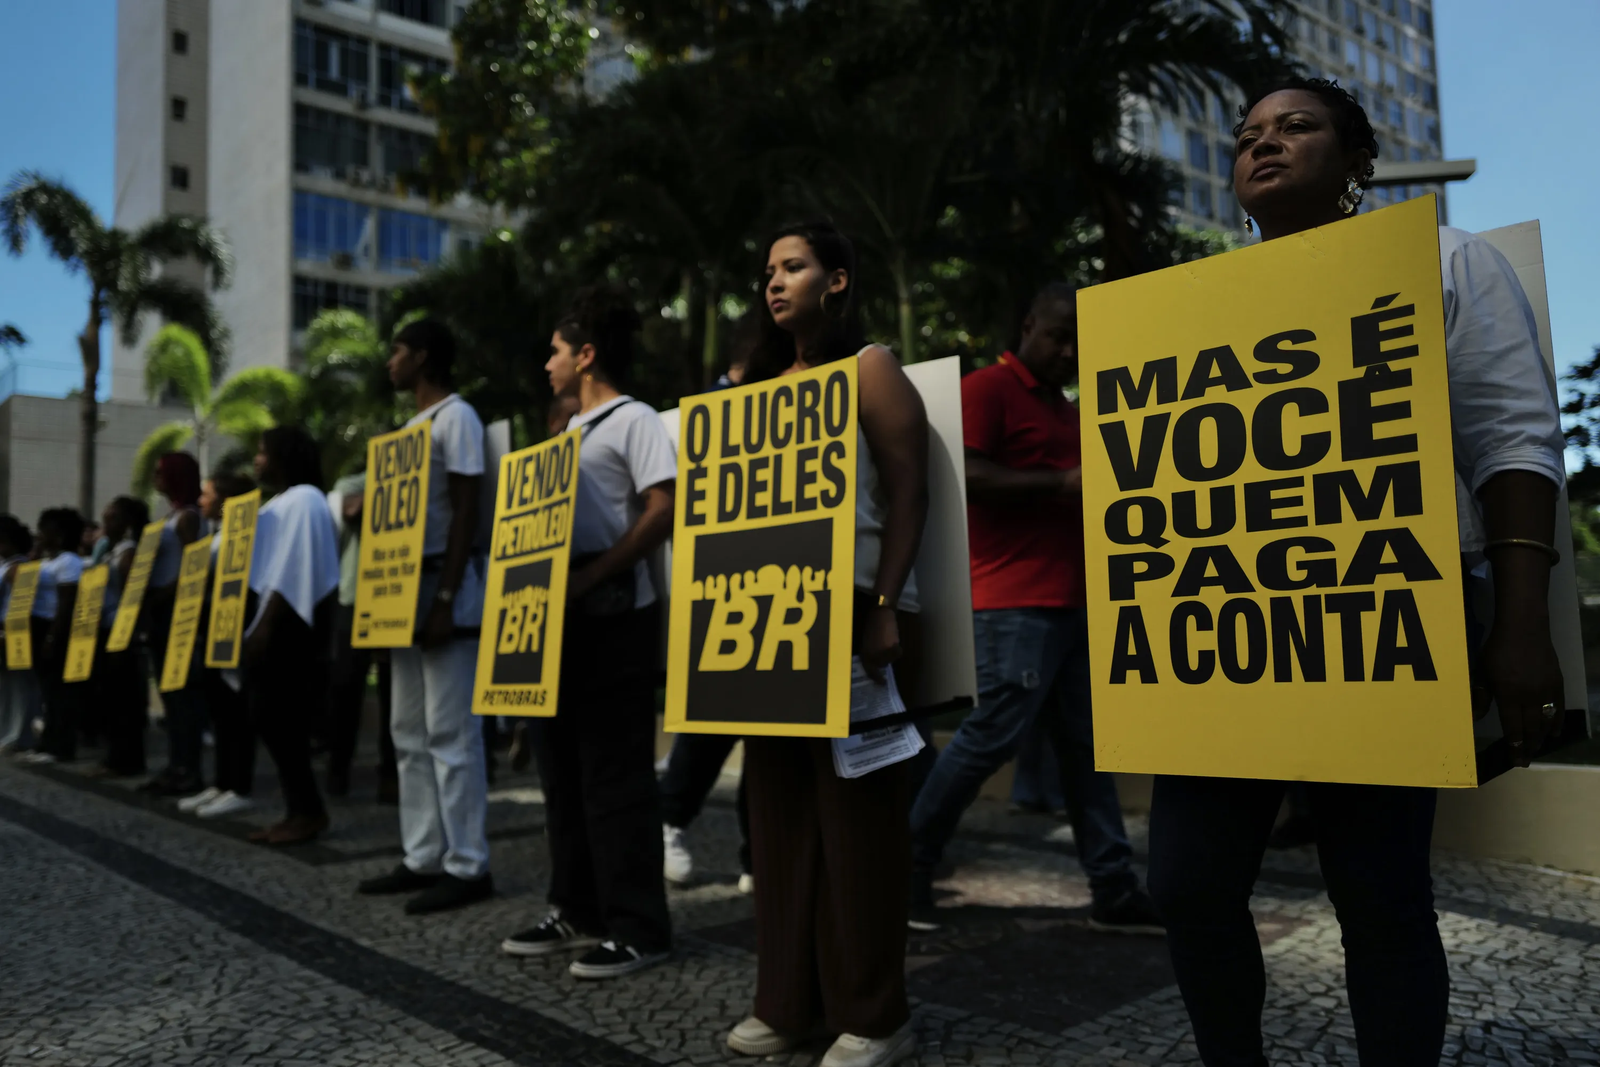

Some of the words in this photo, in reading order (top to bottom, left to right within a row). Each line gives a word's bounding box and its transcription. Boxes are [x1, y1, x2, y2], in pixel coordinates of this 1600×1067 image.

[1096, 328, 1321, 416] MAS
[1350, 292, 1419, 368] É
[375, 429, 425, 482] VENDO
[686, 404, 710, 464] O
[721, 370, 849, 459] LUCRO
[1097, 362, 1419, 492] VOCÊ
[505, 436, 574, 510] VENDO
[717, 440, 846, 523] DELES
[1103, 460, 1424, 549] QUEM
[1107, 526, 1443, 602] PAGA
[498, 603, 548, 654] BR
[698, 591, 818, 672] BR
[1109, 605, 1159, 685] A
[1168, 588, 1438, 685] CONTA
[481, 689, 547, 707] PETROBRAS
